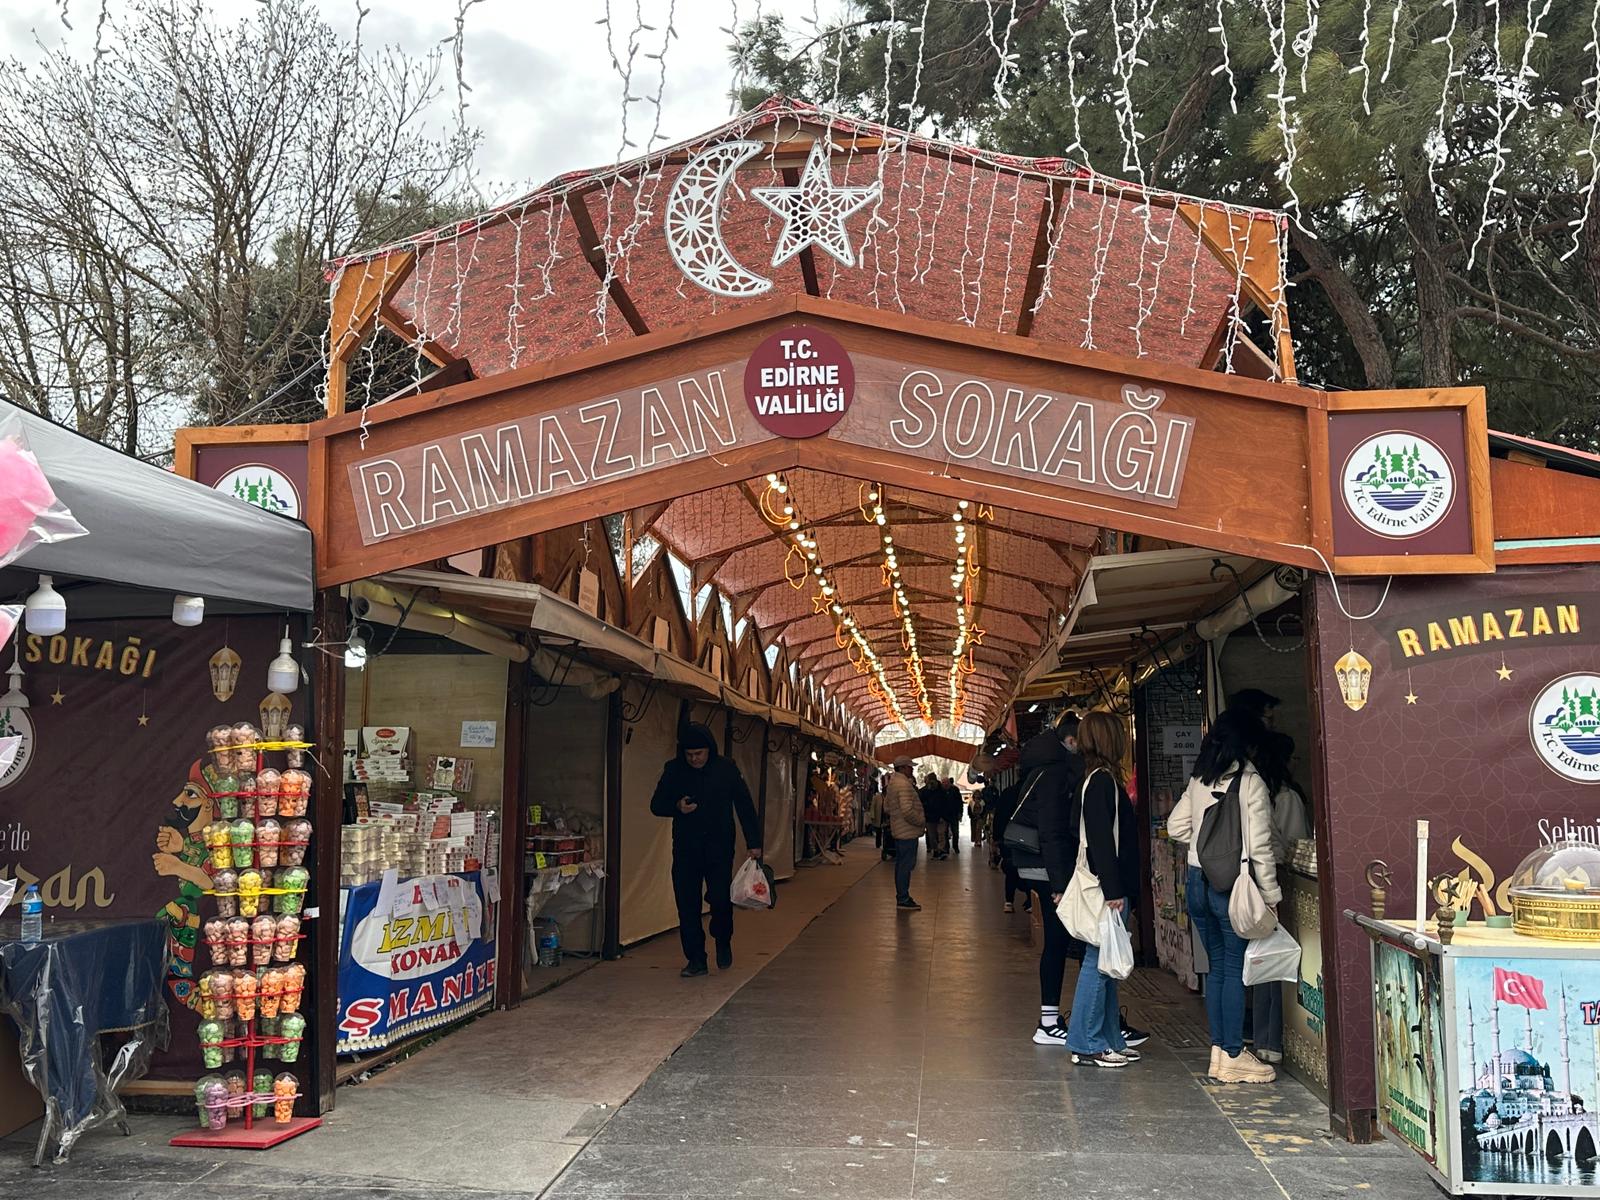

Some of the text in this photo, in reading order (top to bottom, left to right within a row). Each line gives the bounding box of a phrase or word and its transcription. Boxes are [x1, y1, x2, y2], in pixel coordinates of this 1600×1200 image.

[780, 339, 818, 359] T.C.
[760, 362, 839, 388] EDİRNE
[754, 387, 845, 415] VALİLİĞİ
[890, 371, 1188, 499] SOKAĞI
[359, 371, 737, 538] RAMAZAN
[1366, 506, 1407, 528] Edirne
[1409, 485, 1444, 525] Valiliği
[1396, 604, 1581, 658] RAMAZAN
[1556, 750, 1600, 772] Edirne
